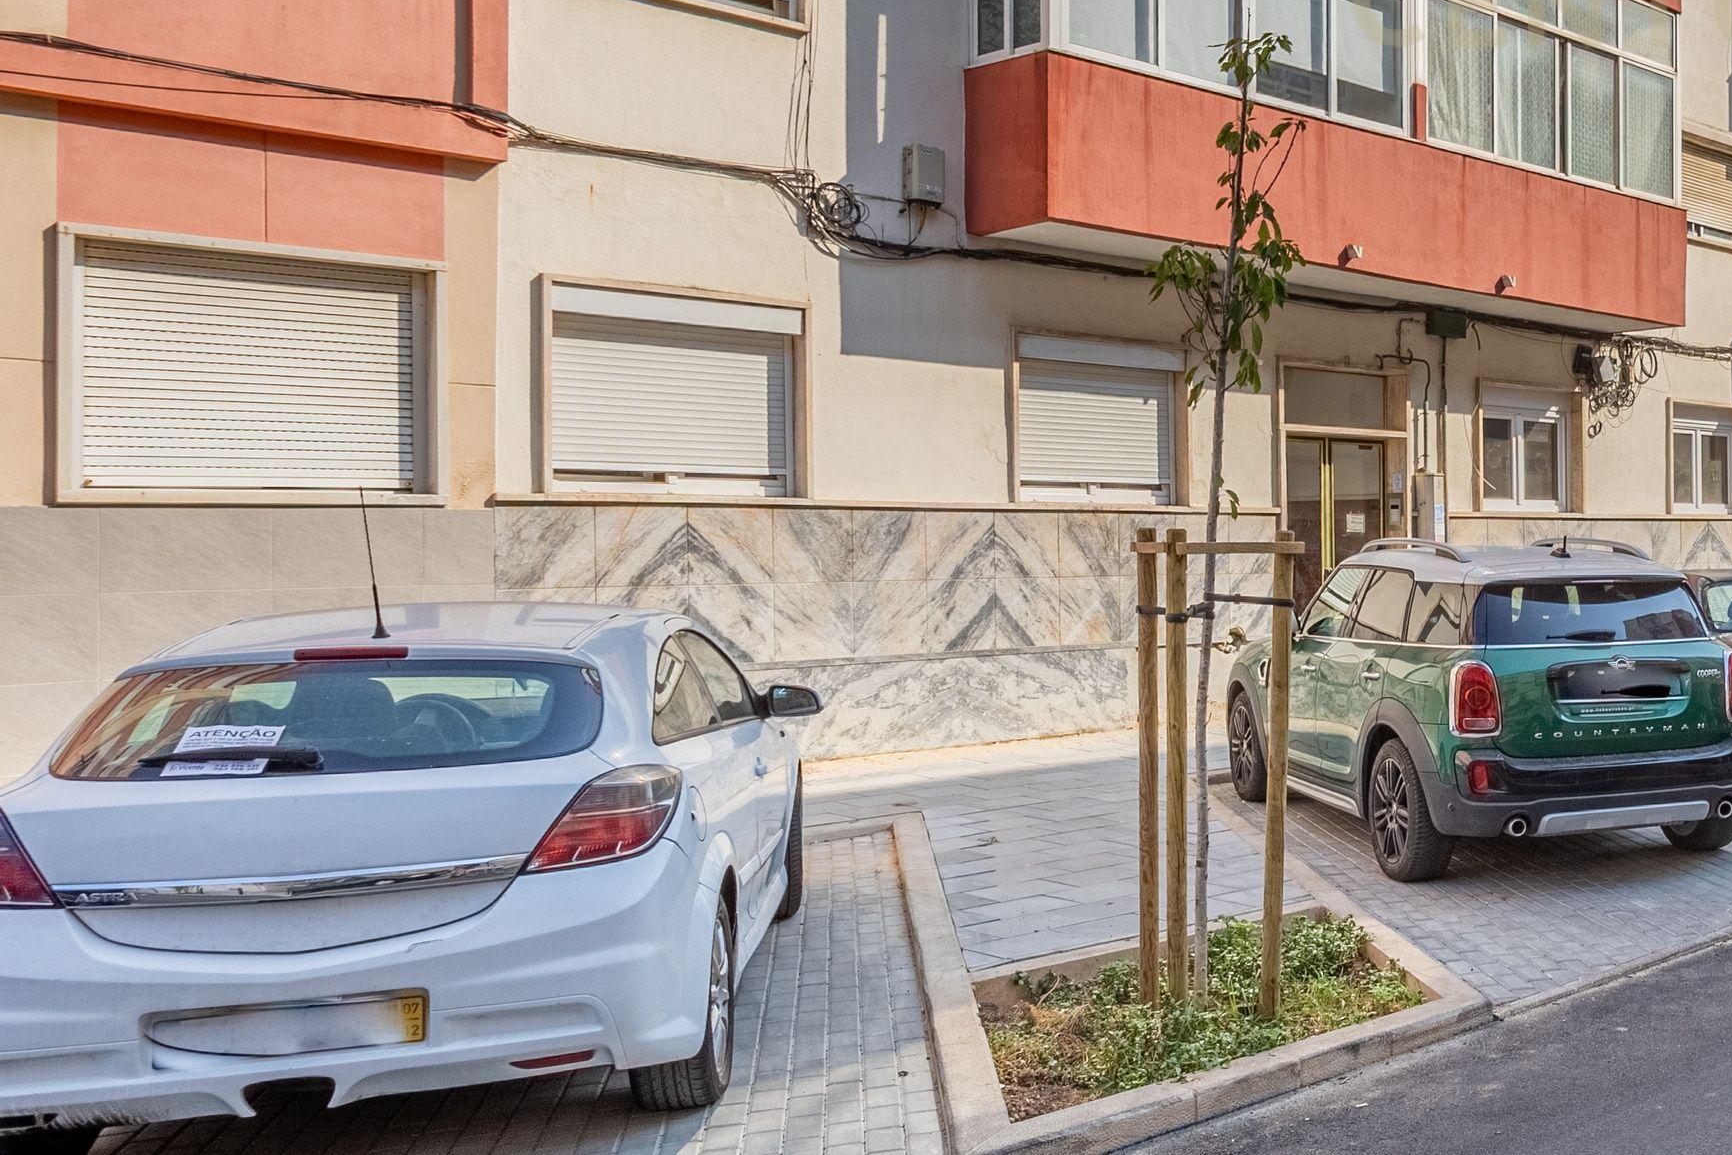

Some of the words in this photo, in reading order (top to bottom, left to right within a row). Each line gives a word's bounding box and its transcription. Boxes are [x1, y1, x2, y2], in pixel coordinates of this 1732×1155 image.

[188, 729, 277, 739] ATENÇÃO
[1534, 723, 1705, 739] COUNTRYMAN
[75, 892, 138, 903] ASTRA
[403, 1002, 420, 1014] 07
